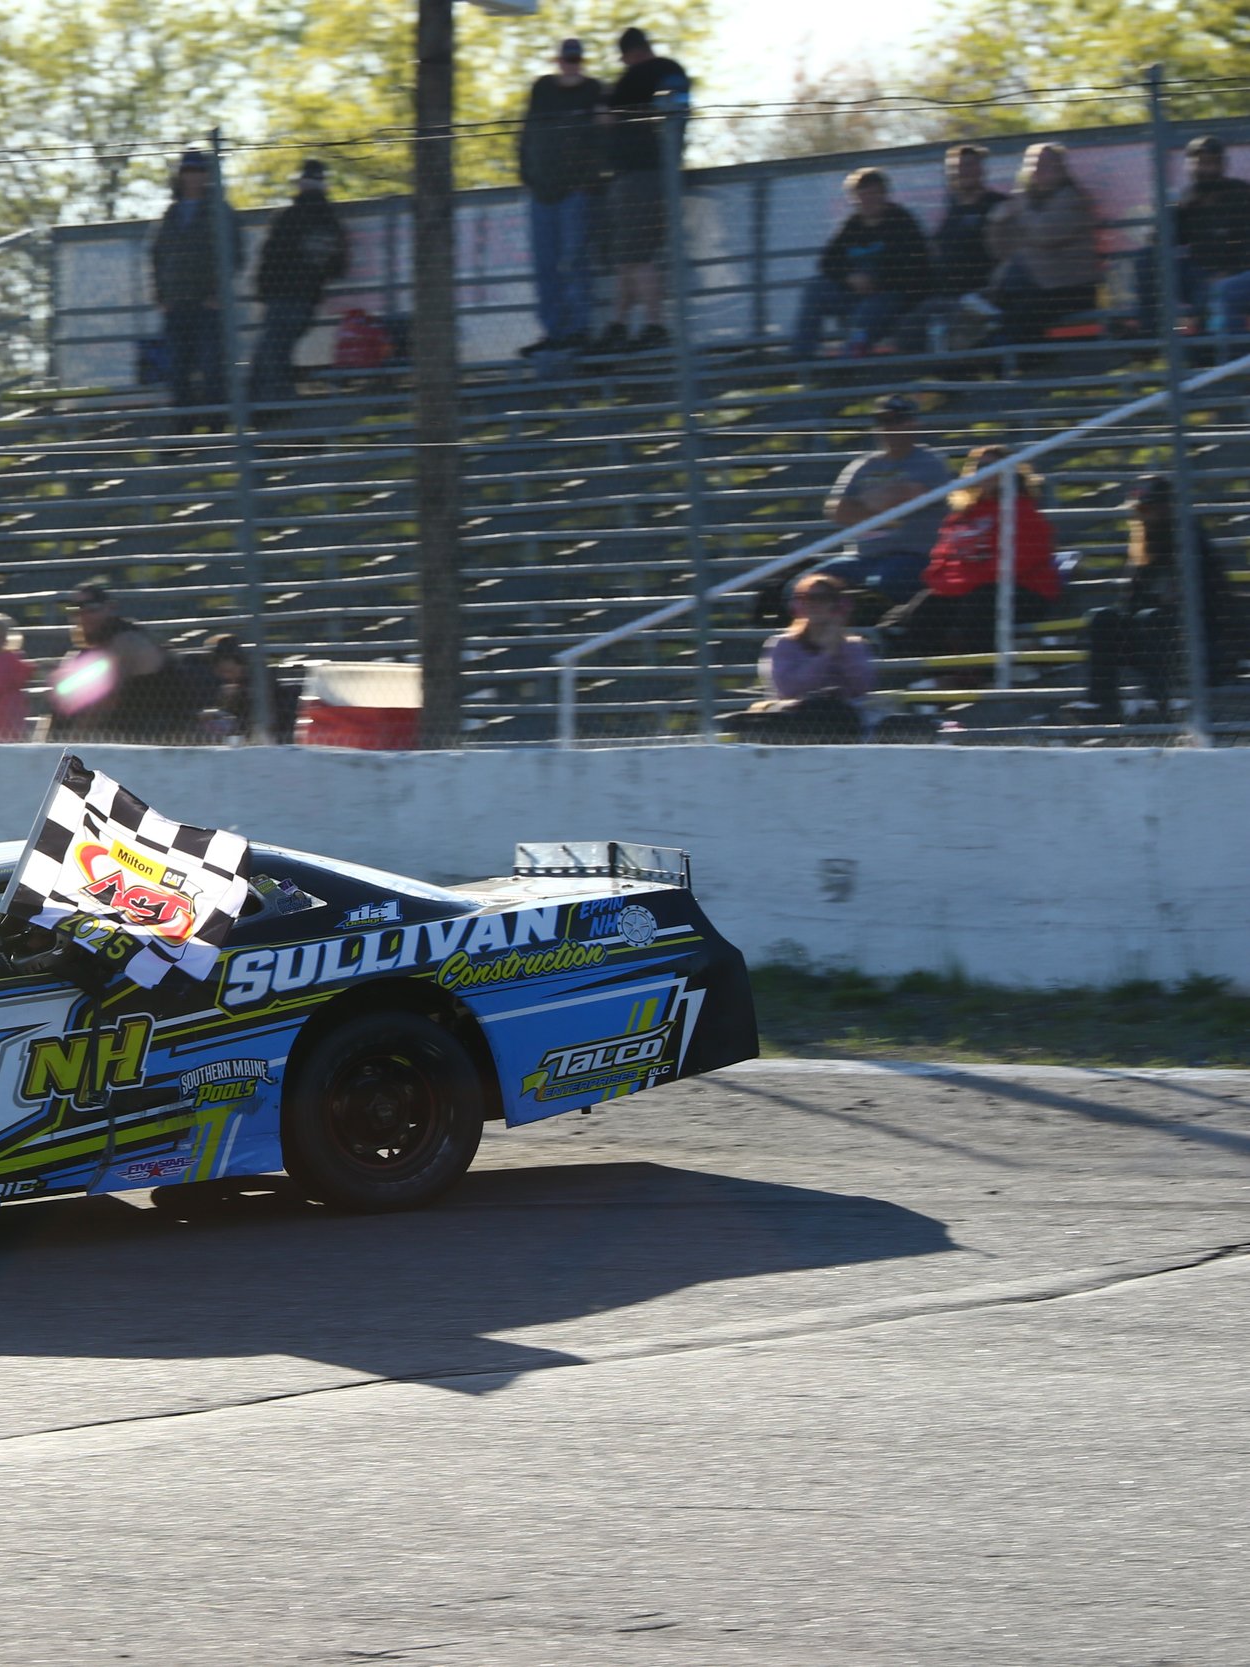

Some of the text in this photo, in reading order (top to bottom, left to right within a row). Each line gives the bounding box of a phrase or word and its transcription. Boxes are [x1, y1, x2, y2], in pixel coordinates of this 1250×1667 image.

[117, 848, 186, 885] Milton CAT
[58, 913, 136, 960] 2025
[590, 912, 620, 938] NH
[224, 905, 560, 1006] SULLIVAN
[438, 940, 607, 989] Construction
[22, 1018, 150, 1105] NH
[181, 1059, 272, 1096] SOUTHERN MAINE
[194, 1079, 257, 1108] POOLS
[544, 1070, 639, 1098] ENTERPRISES
[127, 1162, 155, 1174] FIVE
[158, 1157, 186, 1167] STAR
